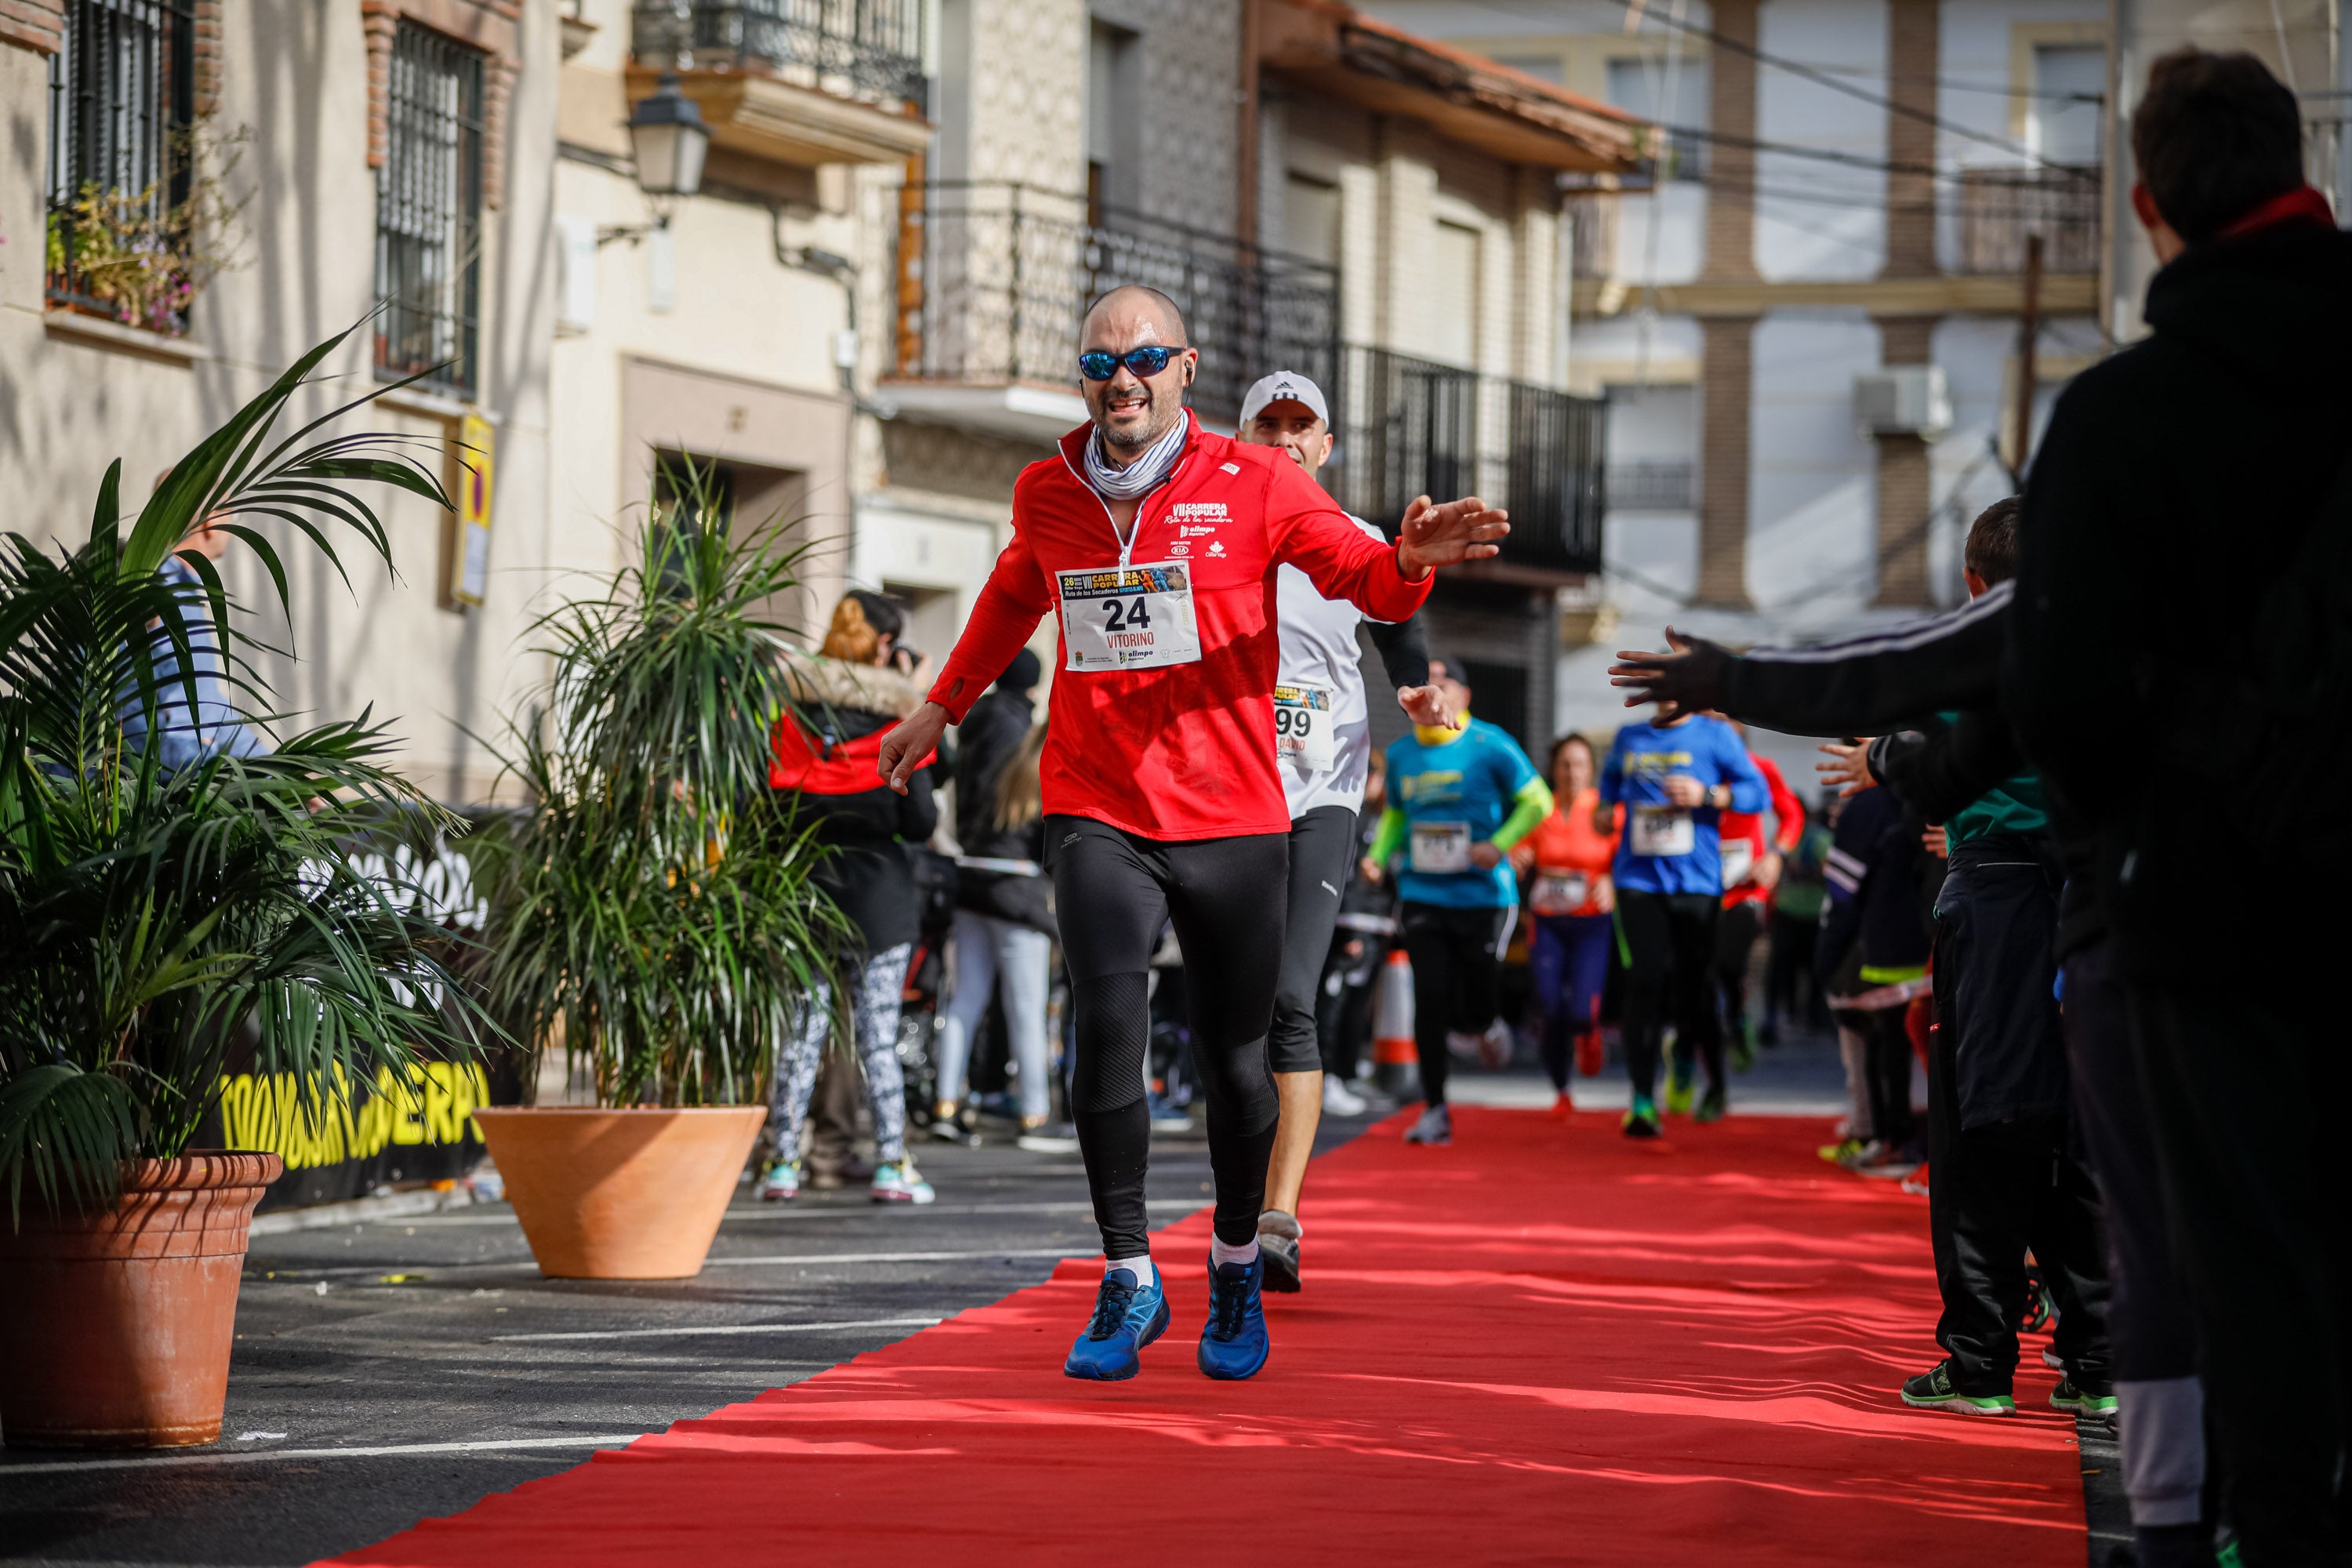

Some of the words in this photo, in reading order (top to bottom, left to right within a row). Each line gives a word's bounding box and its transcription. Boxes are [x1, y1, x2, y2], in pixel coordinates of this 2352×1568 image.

[1173, 503, 1185, 516] VII
[1164, 515, 1181, 524] Ruta
[1064, 577, 1074, 586] 26
[1082, 575, 1092, 589] VII
[1092, 572, 1139, 582] CARRRA
[1093, 579, 1140, 589] POPUAR
[1102, 596, 1151, 632] 24
[1106, 631, 1154, 649] VITORINO
[1279, 738, 1305, 750] DAVID
